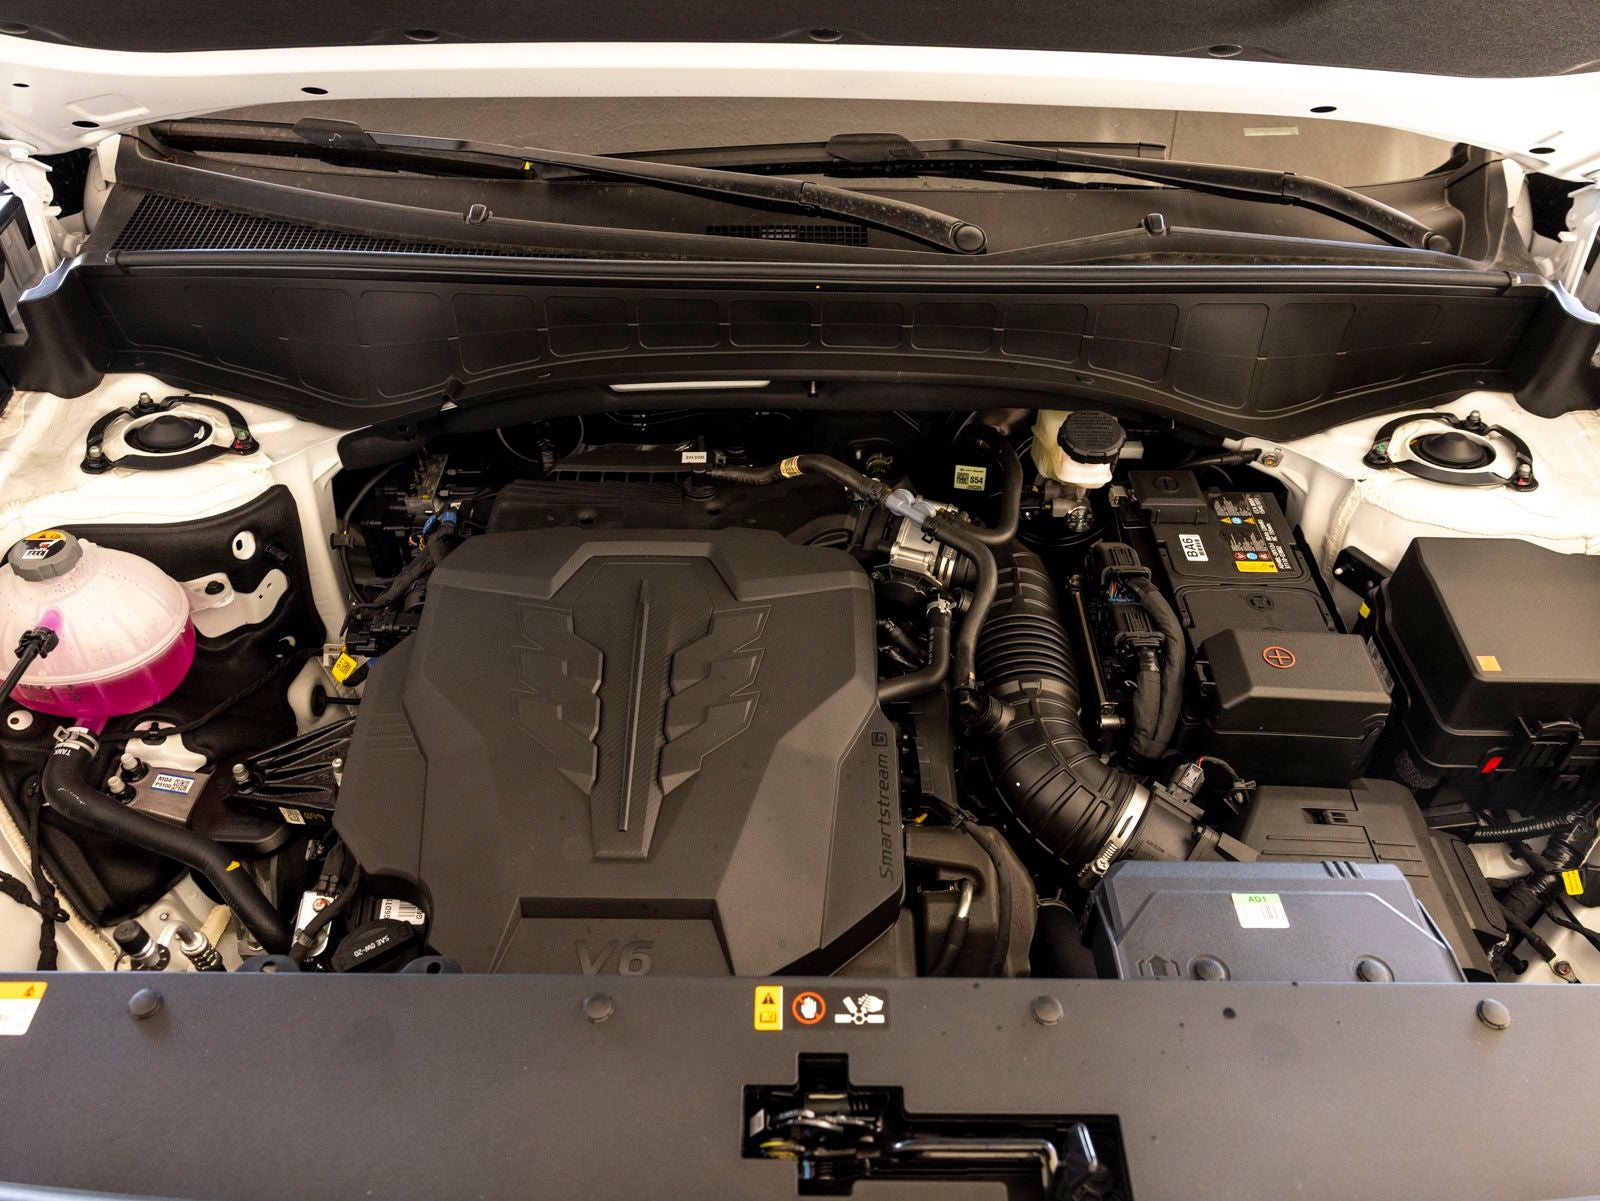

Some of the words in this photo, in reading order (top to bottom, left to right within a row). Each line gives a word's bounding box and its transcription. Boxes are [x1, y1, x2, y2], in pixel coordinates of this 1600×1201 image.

[969, 476, 983, 484] S54
[1182, 538, 1198, 557] BA6
[877, 753, 894, 882] Smartstream
[375, 935, 390, 947] SAE
[574, 939, 656, 976] V6
